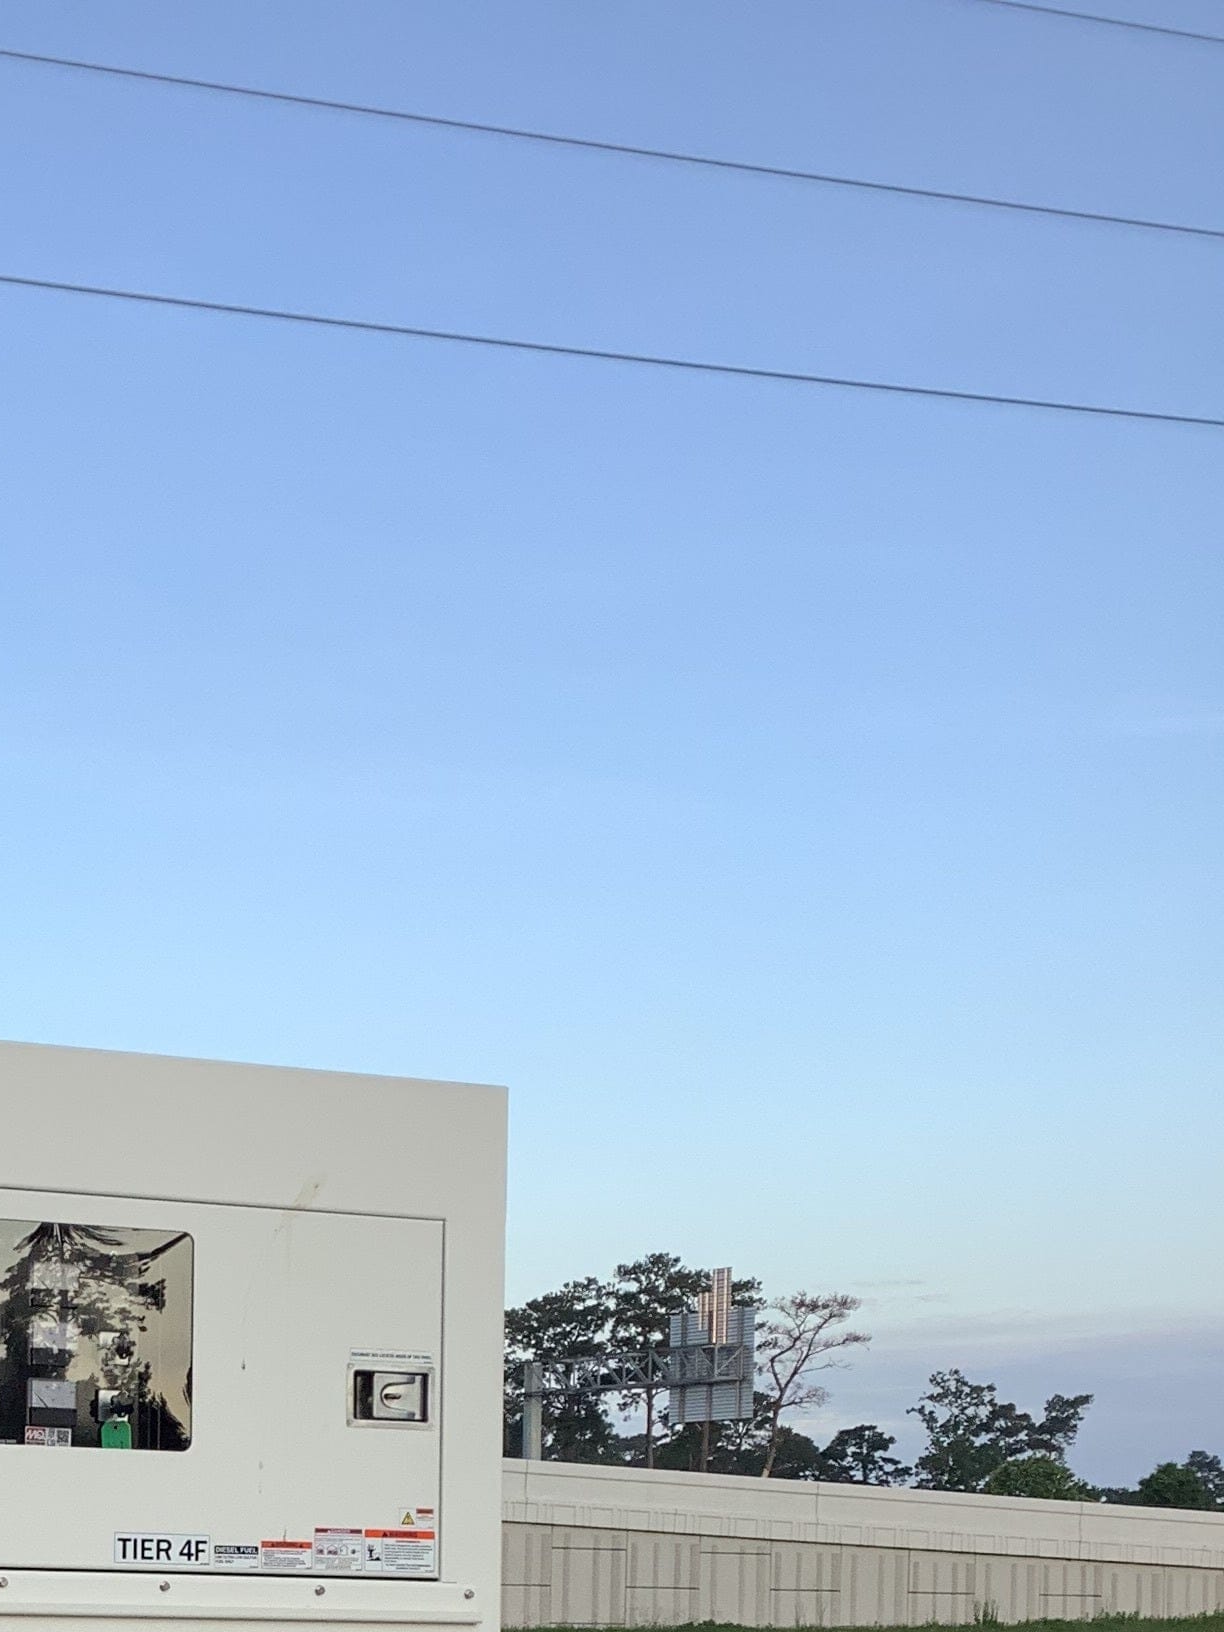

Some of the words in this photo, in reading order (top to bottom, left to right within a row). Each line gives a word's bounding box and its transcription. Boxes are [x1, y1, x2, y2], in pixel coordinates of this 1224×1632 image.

[117, 1537, 172, 1561] TIER
[179, 1539, 208, 1561] 4F
[215, 1546, 239, 1554] DIESEL
[240, 1546, 258, 1554] FUEL
